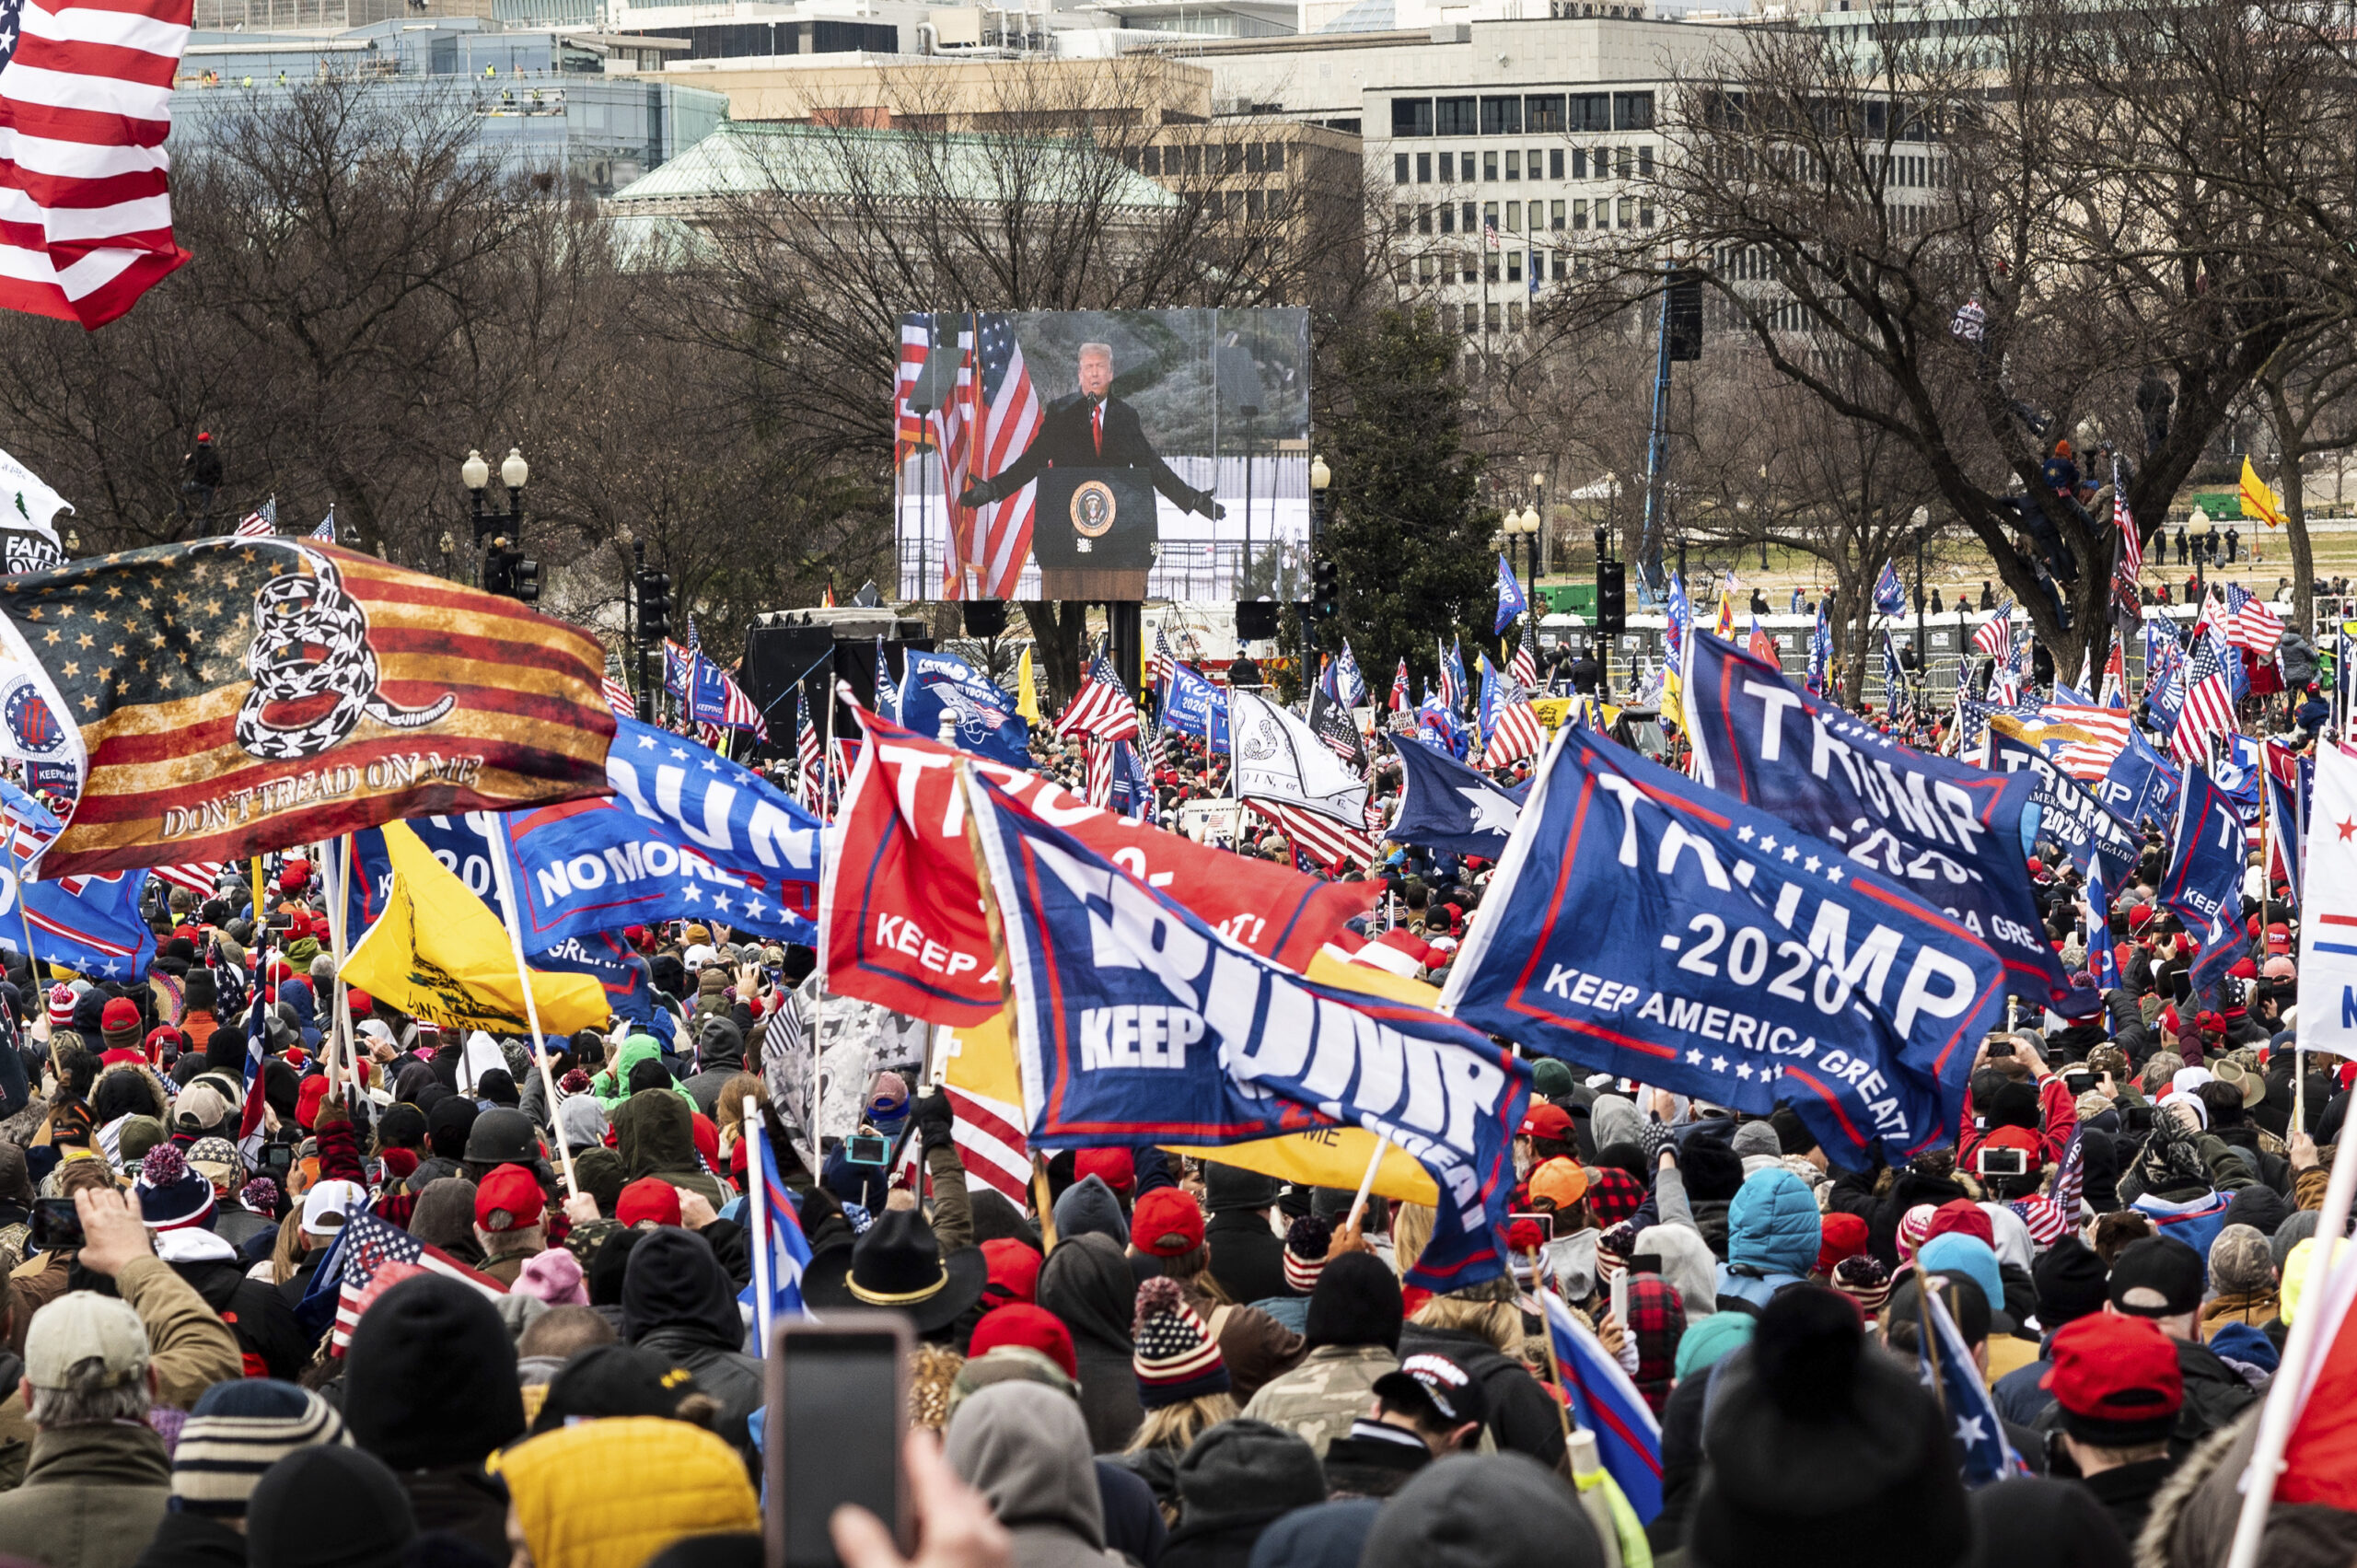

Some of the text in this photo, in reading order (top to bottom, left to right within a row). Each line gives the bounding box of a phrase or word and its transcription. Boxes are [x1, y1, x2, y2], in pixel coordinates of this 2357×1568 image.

[696, 703, 724, 714] KEEPING
[1182, 697, 1206, 714] 2020
[1390, 711, 1411, 721] STOP
[1392, 722, 1414, 731] STEAL
[1241, 773, 1277, 788] OIN,
[1285, 783, 1298, 792] or
[1743, 679, 1985, 856] TRUMP
[159, 751, 484, 840] DON'T TREAD ON ME
[2040, 806, 2088, 846] 2020
[2095, 839, 2134, 864] AGAIN!
[537, 854, 607, 908] NO
[876, 912, 977, 975] KEEP
[1080, 1005, 1206, 1072] KEEP
[1544, 963, 1910, 1142] KEEP AMERICA GREAT!
[1402, 1353, 1469, 1387] TRUMP
